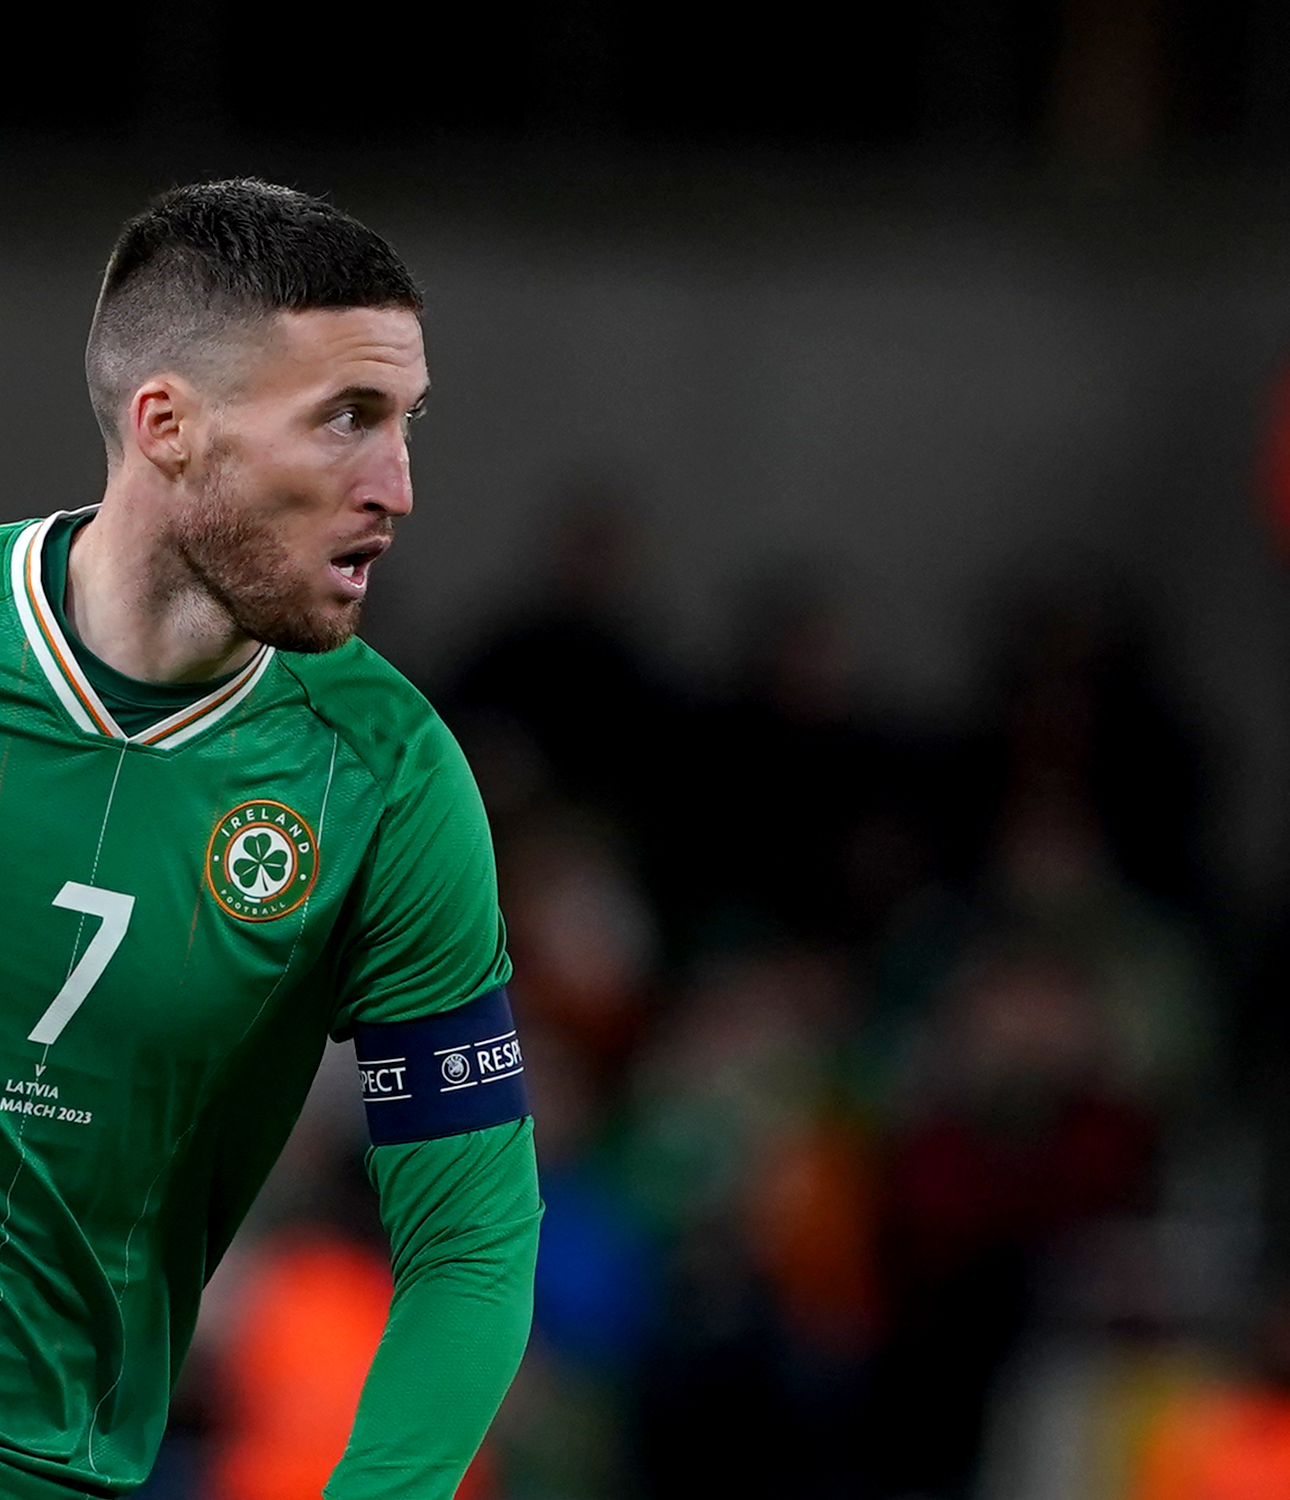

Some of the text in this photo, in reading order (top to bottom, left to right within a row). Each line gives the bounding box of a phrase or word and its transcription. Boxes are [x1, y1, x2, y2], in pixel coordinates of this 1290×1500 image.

[221, 808, 310, 853] IRELAND
[220, 889, 286, 915] FOOTBALL
[27, 880, 136, 1045] 7
[5, 1079, 59, 1099] LATVIA
[0, 1097, 56, 1118] MARCH
[56, 1107, 93, 1125] 2023
